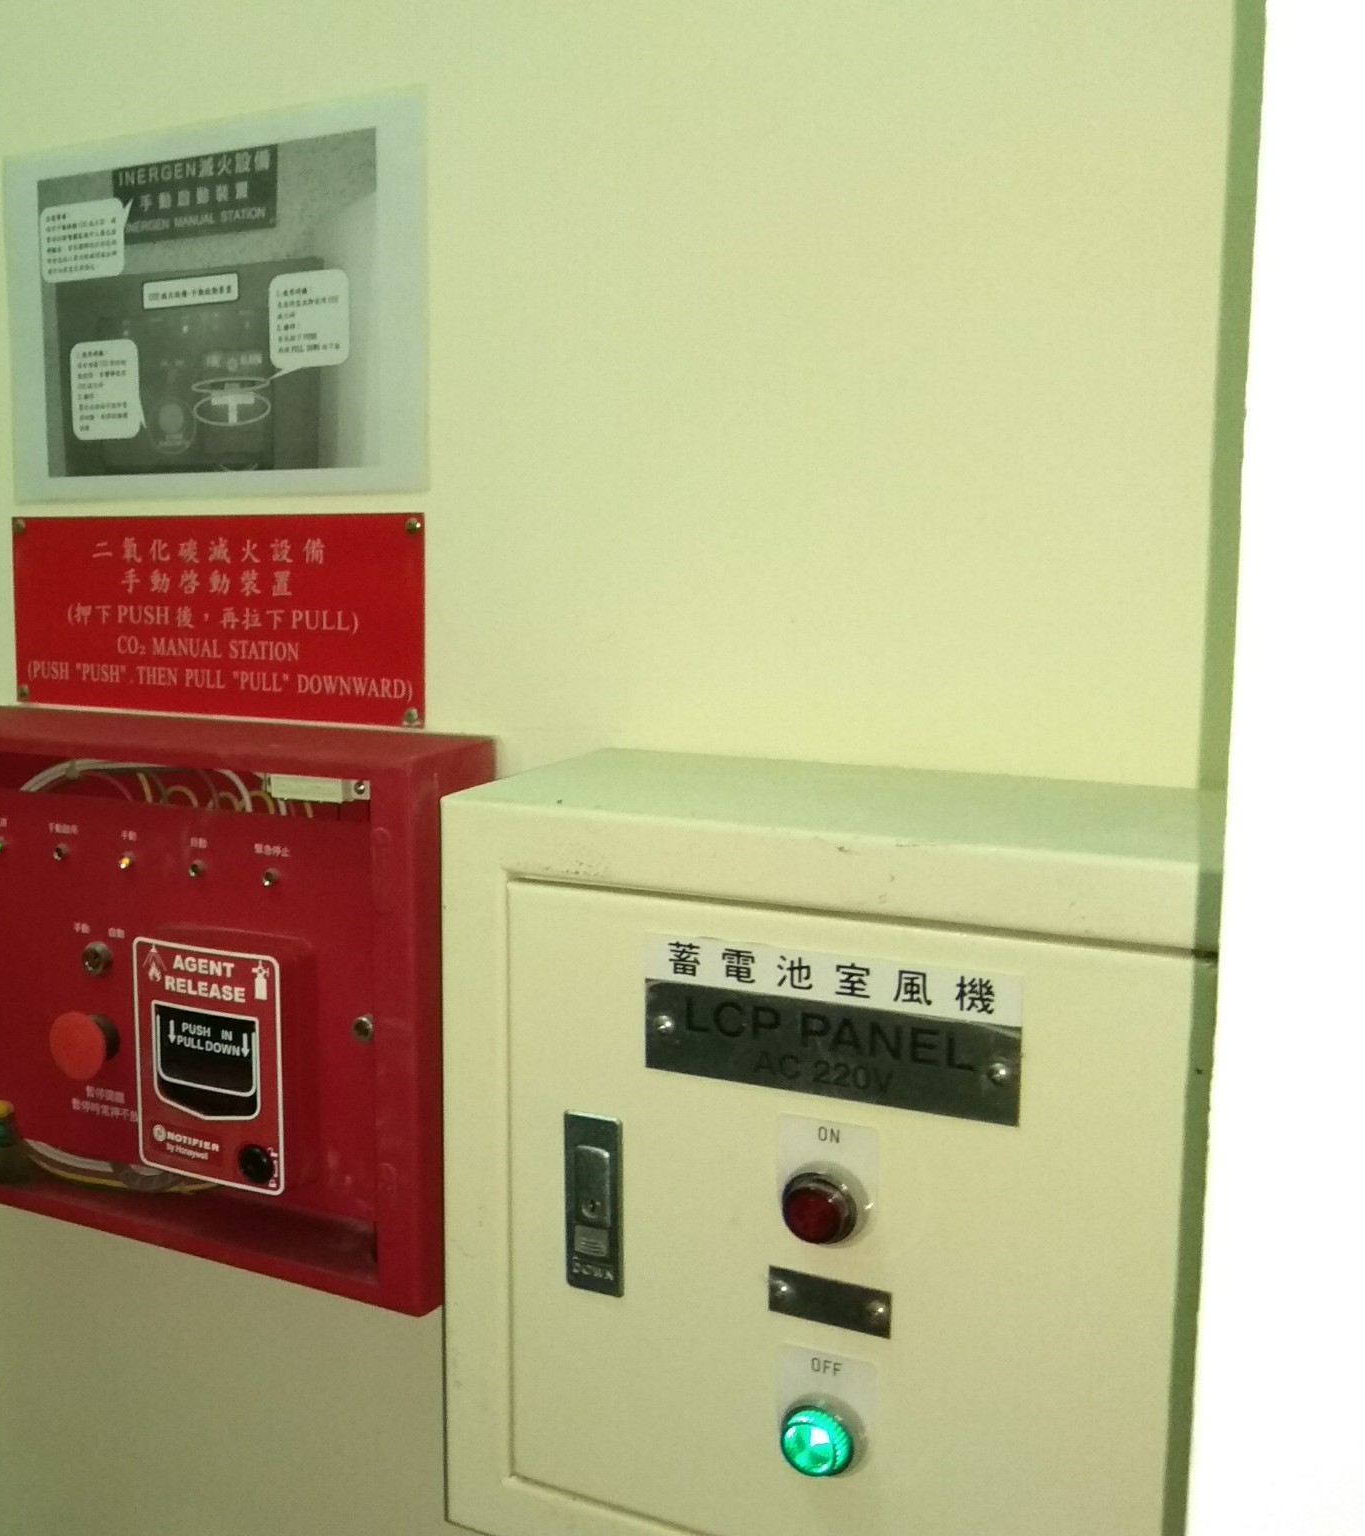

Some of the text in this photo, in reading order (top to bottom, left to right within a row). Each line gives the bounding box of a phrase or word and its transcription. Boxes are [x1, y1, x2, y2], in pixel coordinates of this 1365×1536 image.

[174, 213, 215, 228] MANUAL
[220, 207, 267, 224] STATION
[92, 537, 325, 565] 二氧化碳滅火設備
[152, 636, 222, 659] MANUAL
[229, 640, 299, 661] STATION
[27, 660, 69, 681] (PUSH
[185, 668, 226, 689] PULL
[233, 671, 290, 692] "PULL"
[297, 674, 413, 702] DOWNWARD)
[172, 954, 235, 978] AGENT
[668, 941, 996, 1015] 蓄電池室風機
[164, 975, 246, 1003] RELEASE
[181, 1022, 234, 1042] PUSH IN
[684, 996, 976, 1073] LCP PANEL
[176, 1034, 241, 1057] PULL DOWN
[754, 1051, 895, 1094] AC 220V
[166, 1131, 220, 1153] NOTIFIER
[817, 1126, 841, 1145] ON
[810, 1357, 843, 1378] OFF
